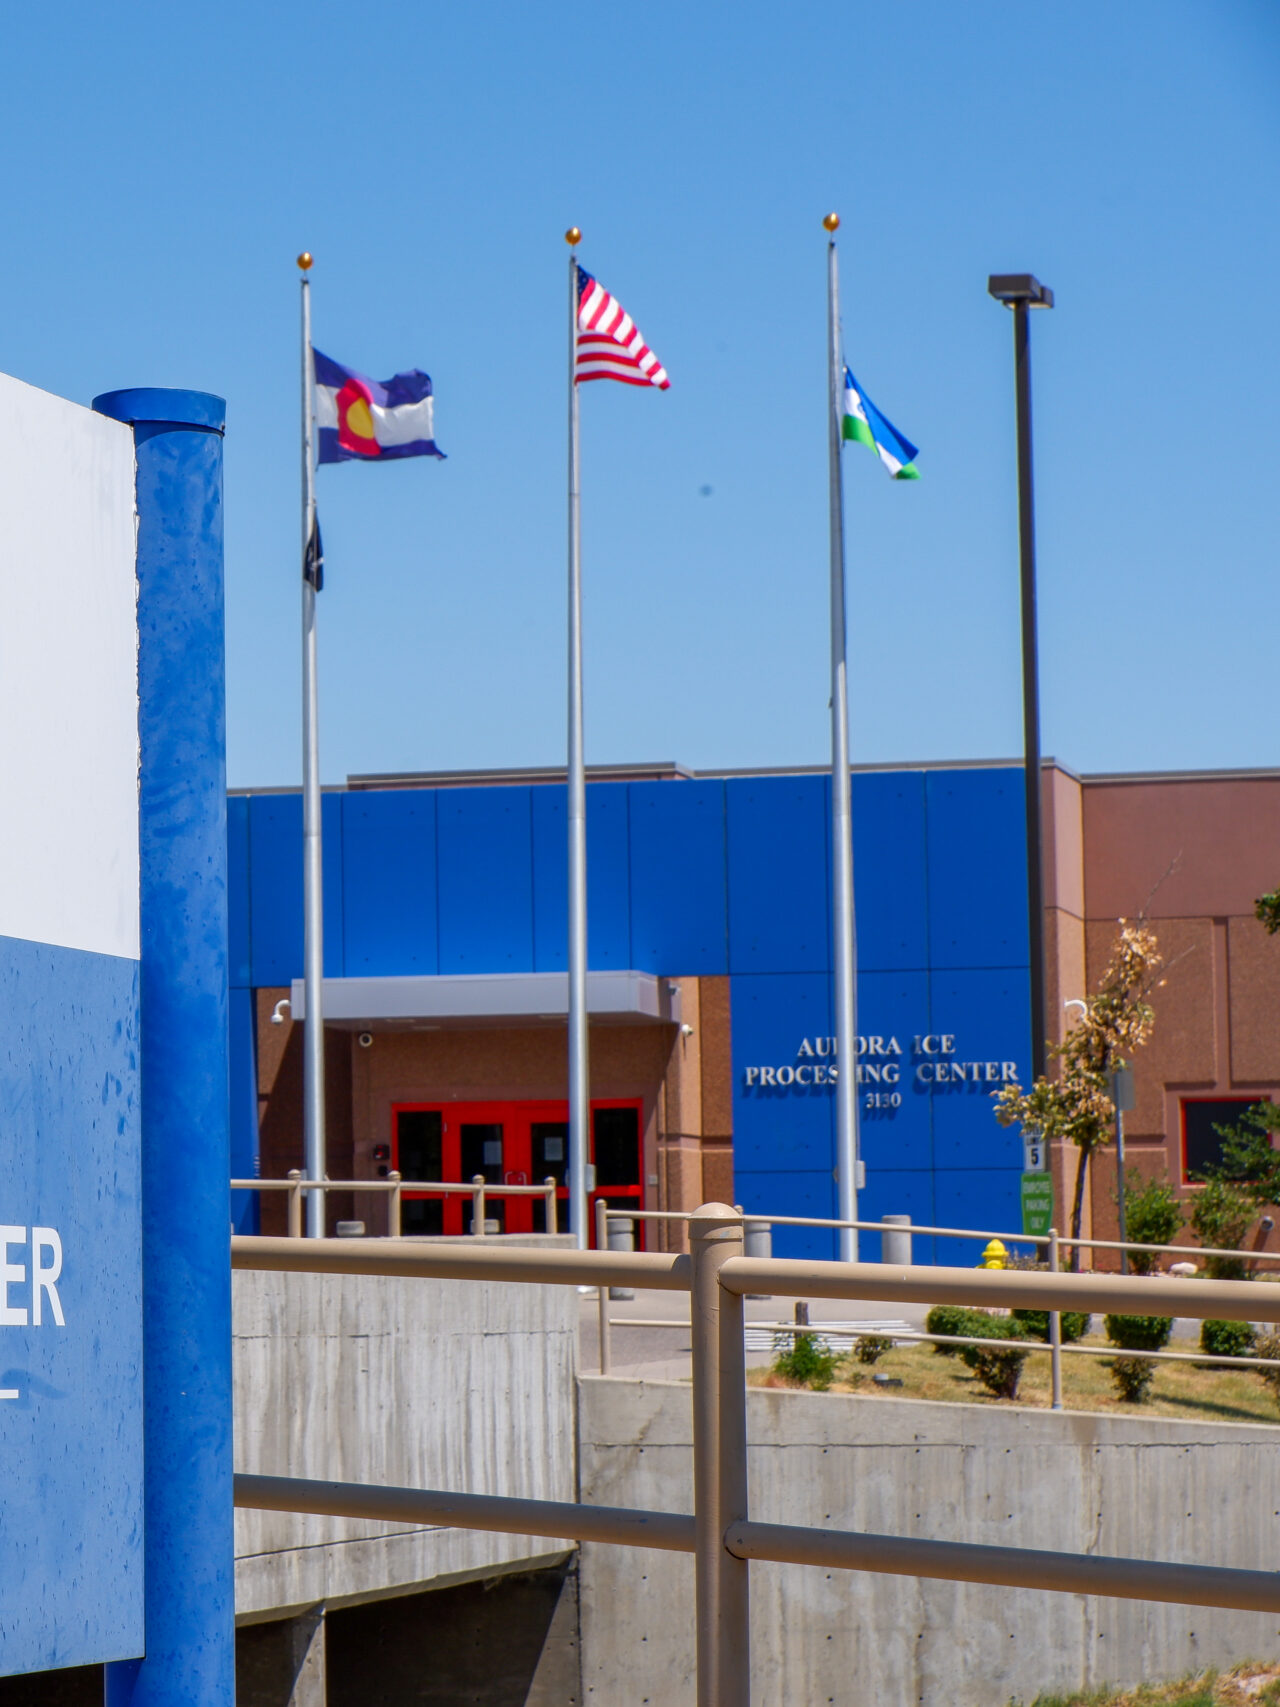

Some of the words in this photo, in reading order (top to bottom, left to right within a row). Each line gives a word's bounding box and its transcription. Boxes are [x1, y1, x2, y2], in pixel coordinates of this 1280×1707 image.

[797, 1035, 902, 1056] AUORA
[914, 1034, 956, 1054] ICE
[745, 1063, 900, 1086] PROCESING
[917, 1061, 1019, 1083] CENTER
[865, 1092, 901, 1109] 3130
[1031, 1147, 1039, 1166] 5
